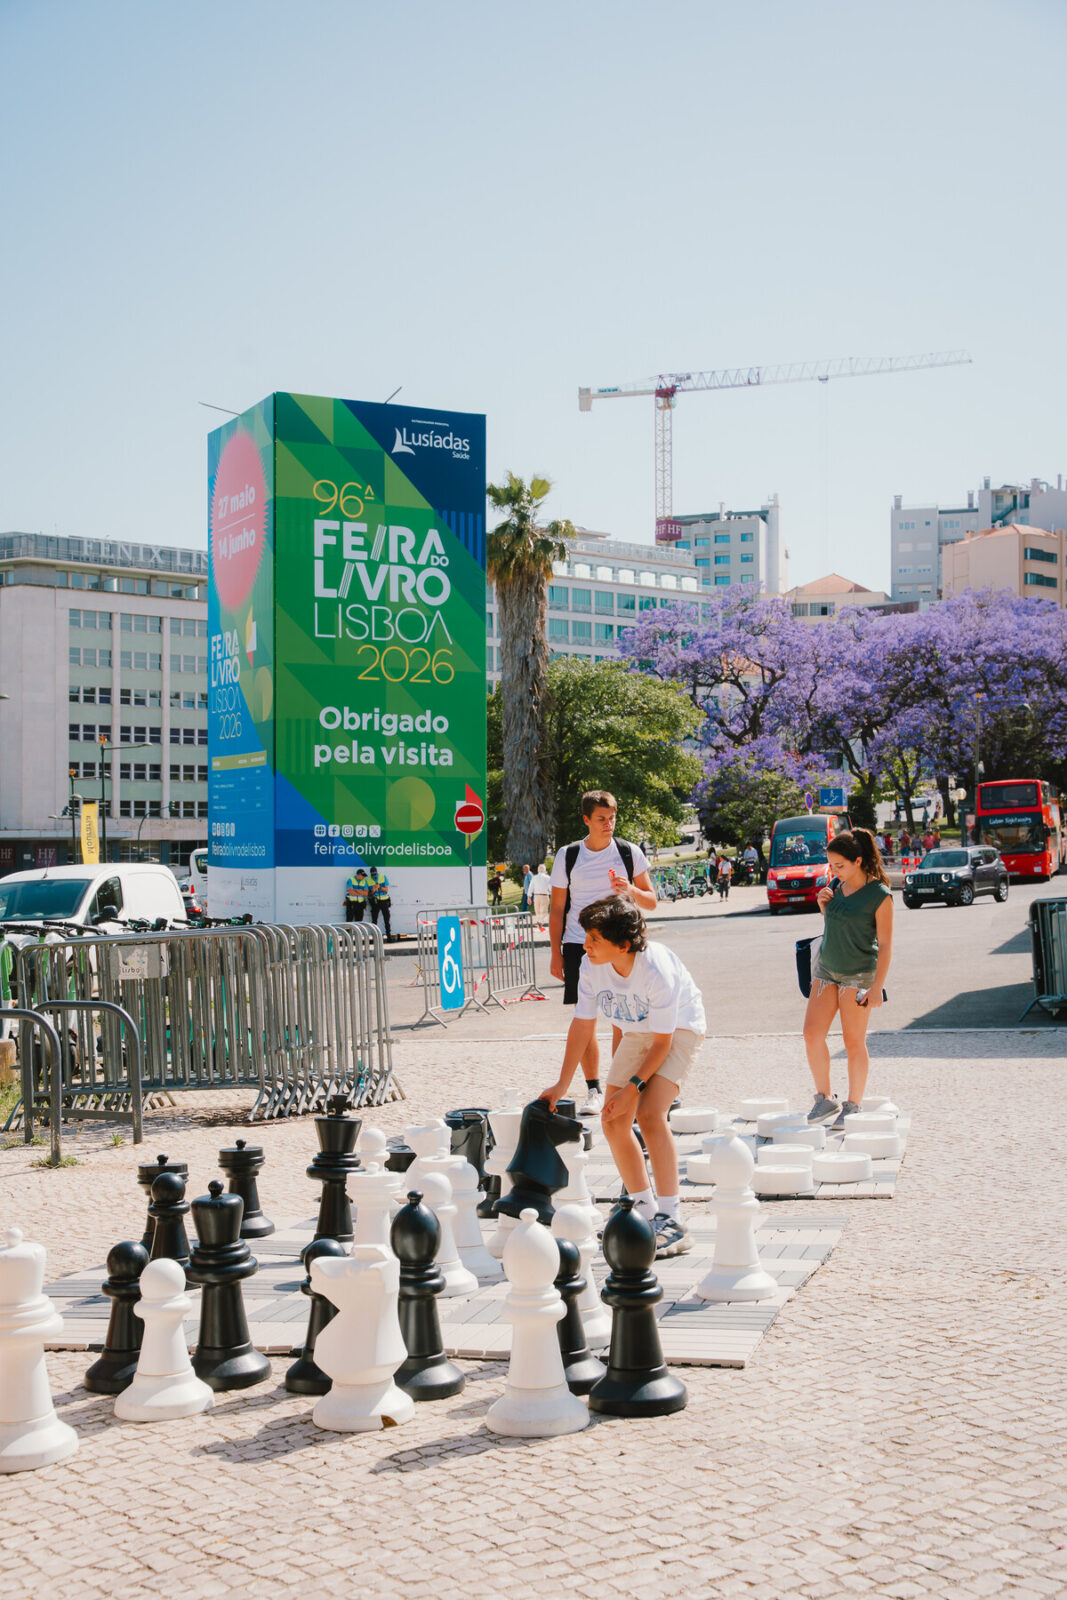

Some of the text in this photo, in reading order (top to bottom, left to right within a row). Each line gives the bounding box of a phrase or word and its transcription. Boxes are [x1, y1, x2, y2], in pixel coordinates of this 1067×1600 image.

[403, 427, 470, 451] Lusíadas
[452, 451, 470, 460] Saúde
[218, 484, 256, 519] 27 maio
[218, 527, 256, 560] 14 junho
[314, 519, 449, 567] FEIRA DO
[314, 559, 451, 606] LIVRO
[315, 602, 453, 645] LISBOA
[211, 629, 239, 660] FEIRA
[211, 656, 240, 687] LIVRO
[357, 644, 455, 684] 2026
[219, 712, 242, 739] 2026
[319, 706, 449, 736] Obrigado
[314, 740, 453, 767] pela visita
[314, 842, 452, 855] feiradolivrodelisboa
